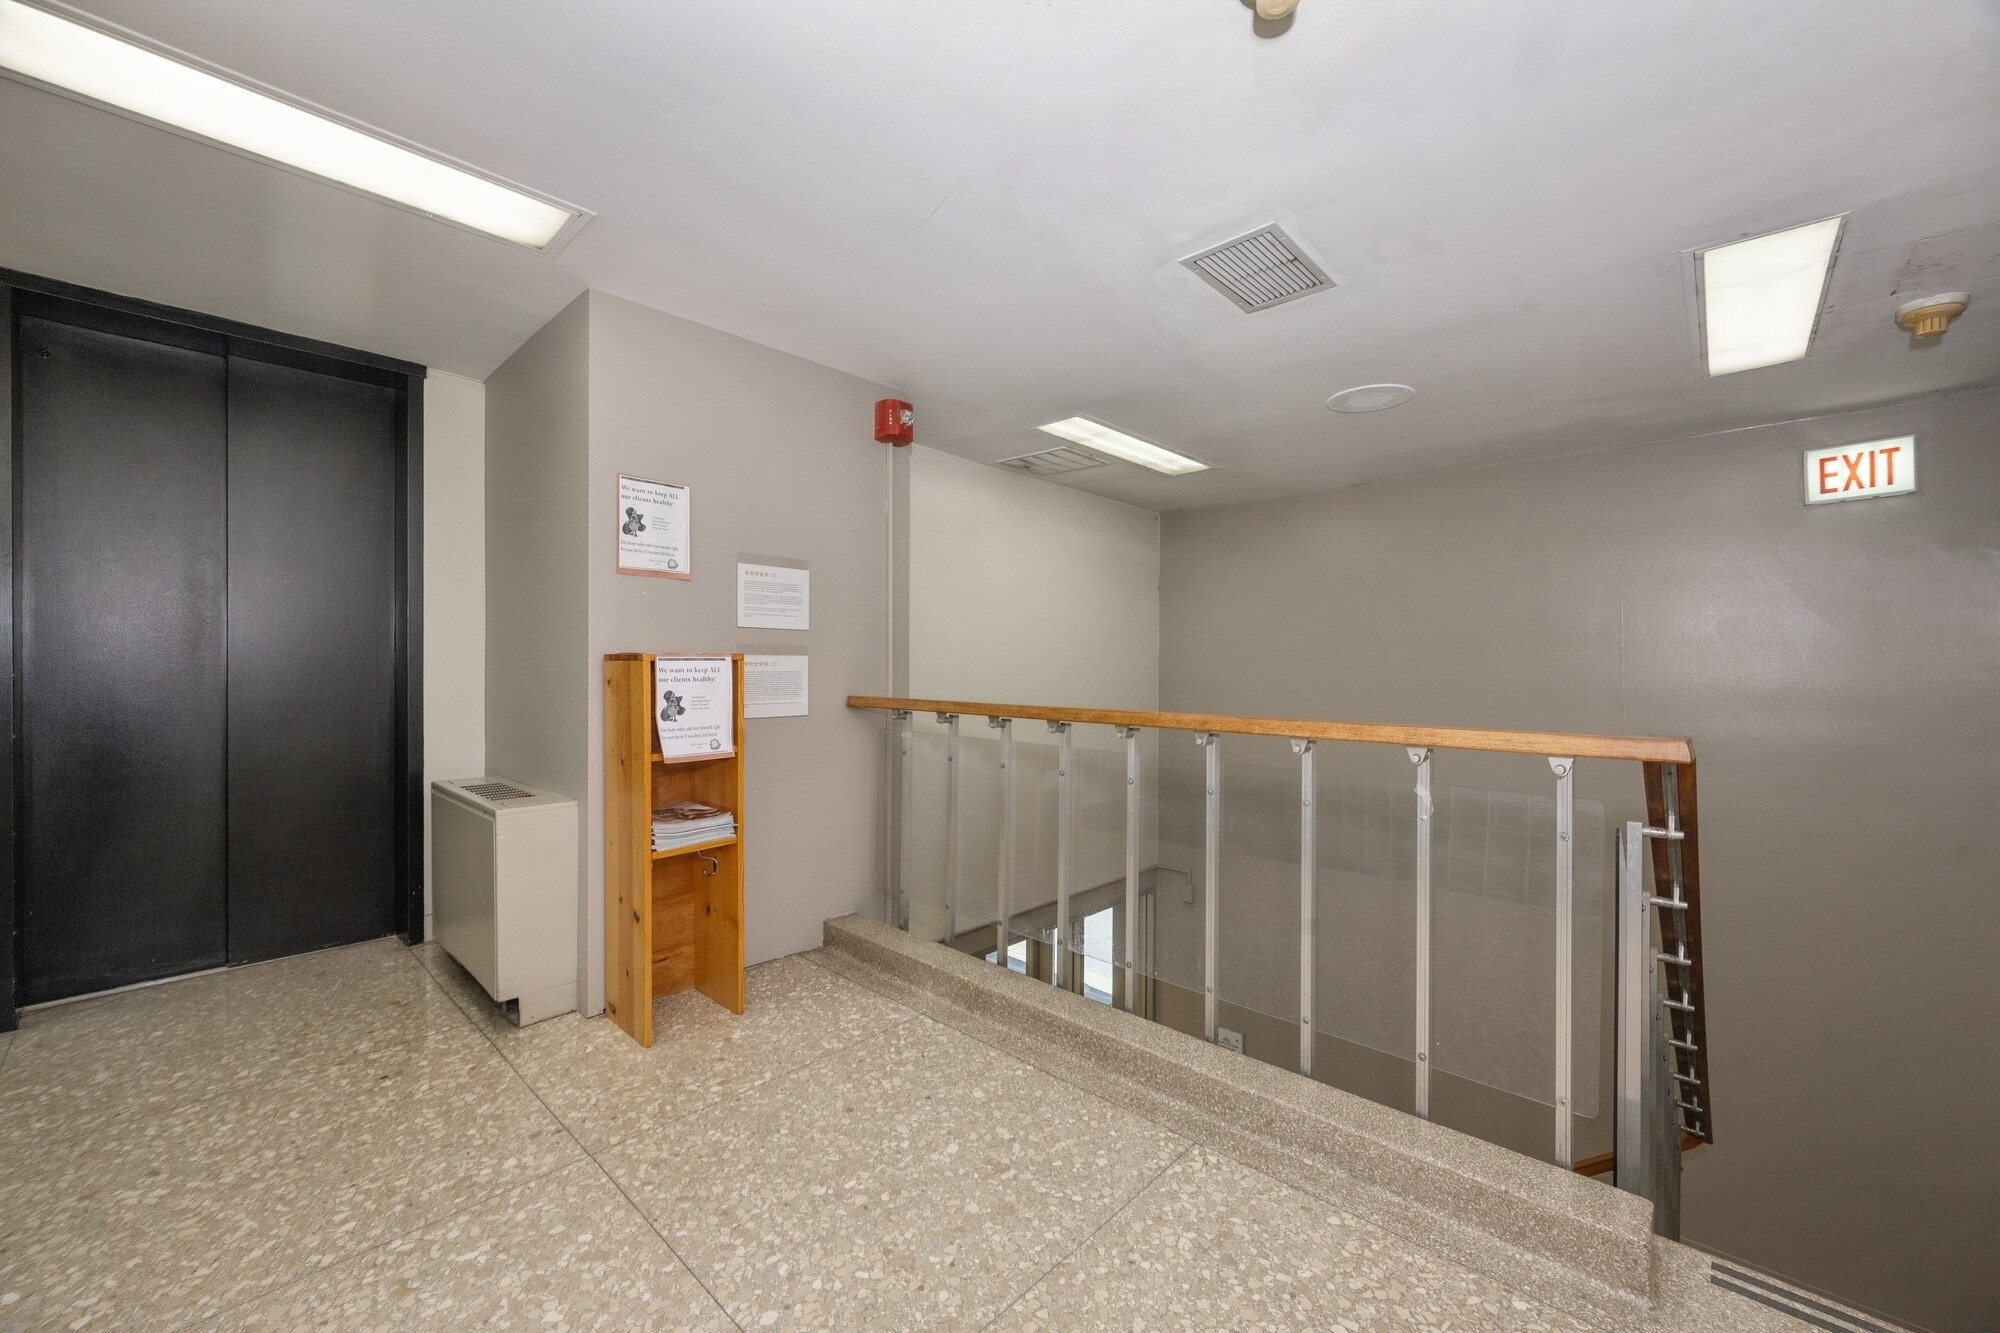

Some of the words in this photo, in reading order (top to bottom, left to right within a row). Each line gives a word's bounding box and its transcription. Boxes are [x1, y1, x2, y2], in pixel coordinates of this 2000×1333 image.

[1819, 447, 1901, 494] EXIT
[632, 495, 652, 503] clients
[655, 490, 668, 499] keep
